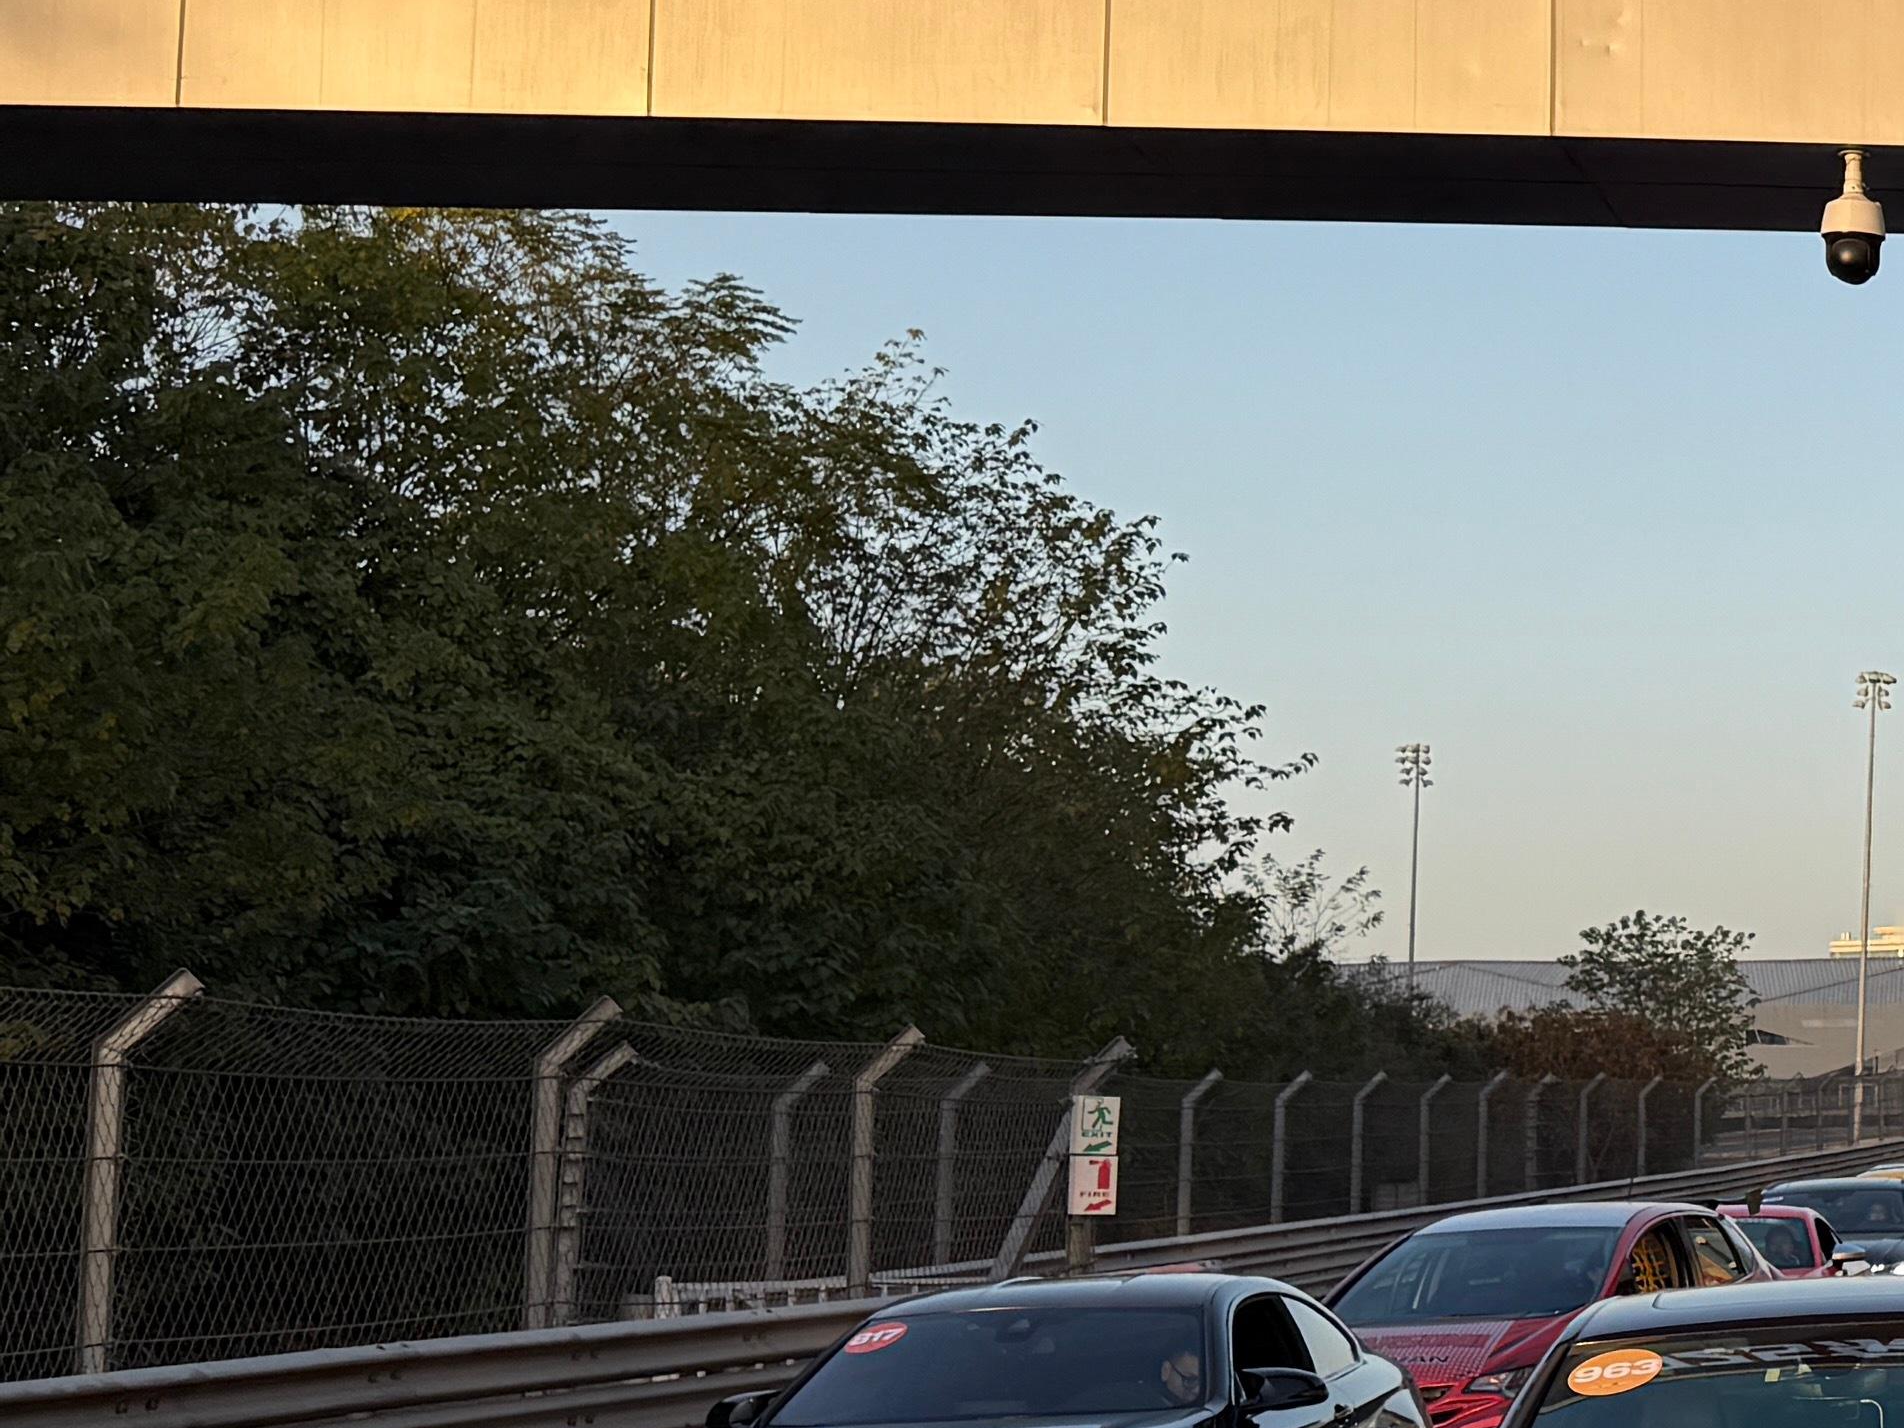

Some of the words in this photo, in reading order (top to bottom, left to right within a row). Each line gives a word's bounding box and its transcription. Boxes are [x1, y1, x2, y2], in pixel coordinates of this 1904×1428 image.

[1081, 1131, 1113, 1139] EXIT
[1080, 1190, 1110, 1198] FIRE
[848, 1327, 905, 1347] 817
[1574, 1358, 1661, 1384] 963
